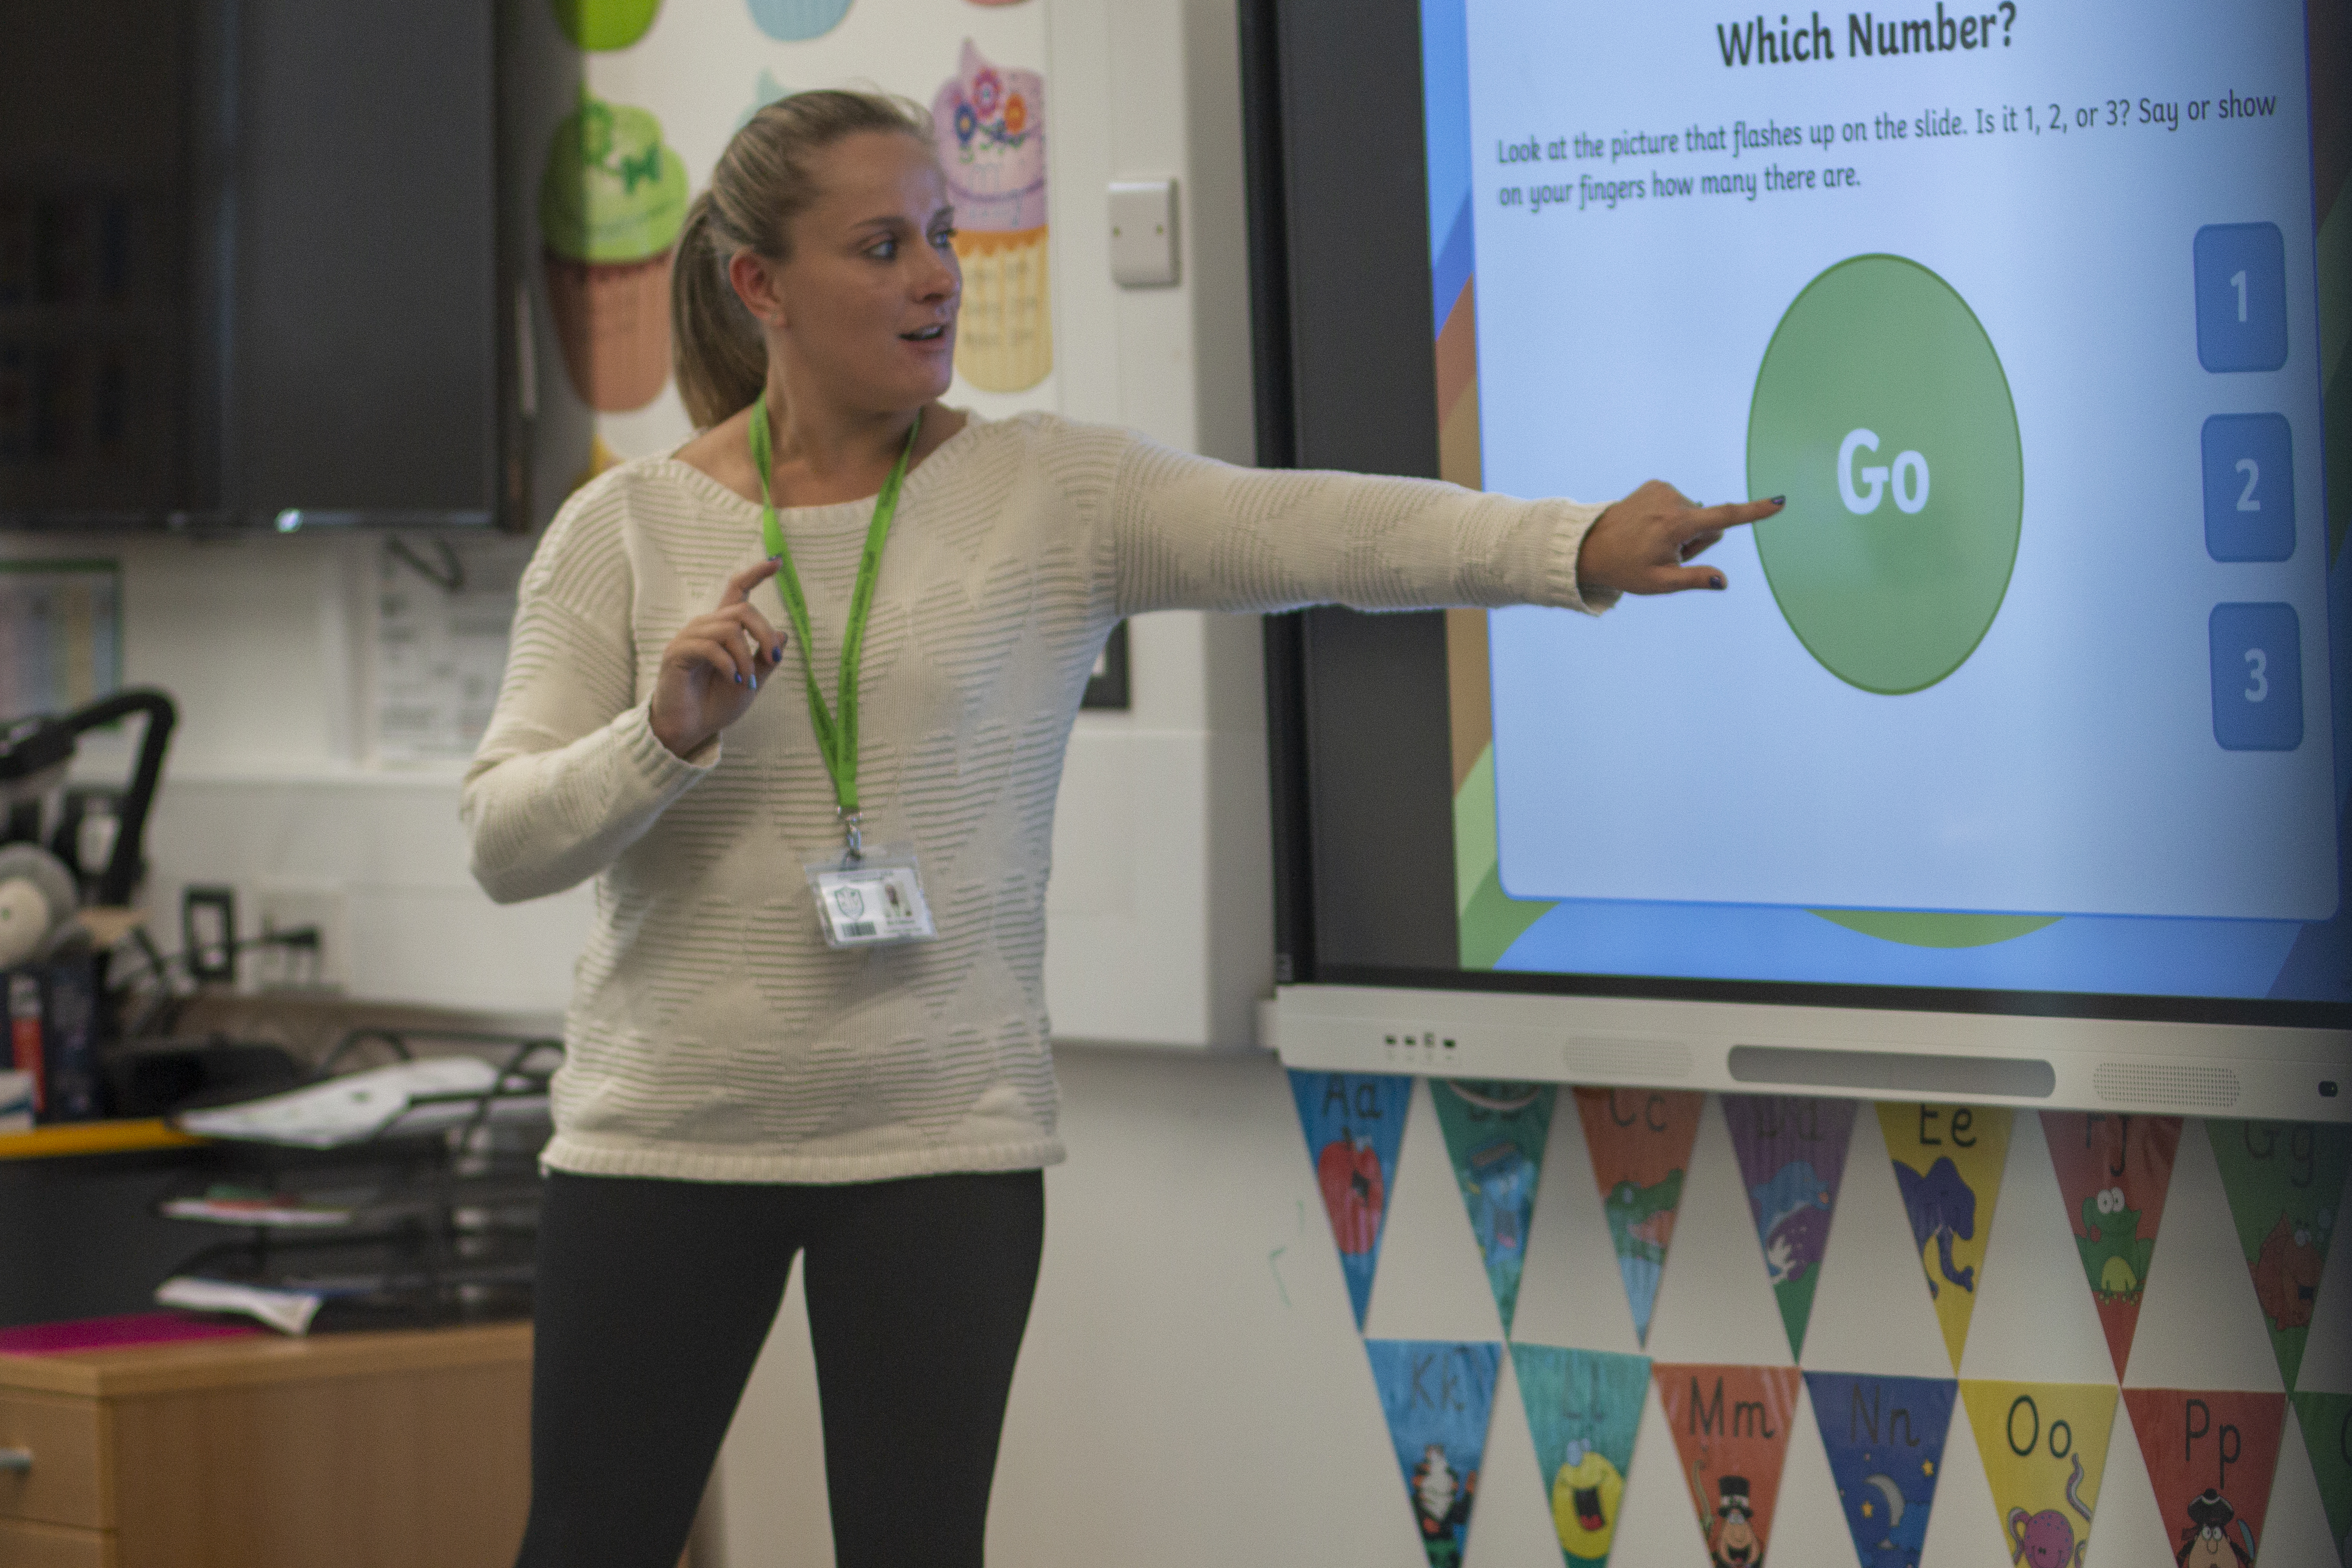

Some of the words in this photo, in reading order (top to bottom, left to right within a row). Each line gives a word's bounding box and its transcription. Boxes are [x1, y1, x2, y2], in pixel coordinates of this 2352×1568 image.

[1717, 11, 1835, 66] Which
[1848, 1, 2016, 57] Number?
[1498, 135, 1540, 163] Look
[1547, 137, 1566, 161] at
[1574, 131, 1603, 158] the
[1612, 130, 1678, 163] picture
[1687, 124, 1726, 152] that
[1733, 120, 1802, 158] flashes
[1810, 124, 1834, 151] up
[1842, 122, 1867, 142] on
[1874, 112, 1908, 140] the
[1914, 108, 1967, 137] slide.
[1976, 108, 1995, 134] Is
[2003, 106, 2018, 132] it
[2025, 106, 2040, 134] 1,
[2049, 104, 2067, 133] 2,
[2076, 103, 2098, 126] or
[2107, 99, 2130, 125] 3?
[2139, 98, 2178, 131] Say
[2188, 99, 2210, 121] or
[2218, 90, 2276, 118] show
[1500, 186, 1522, 205] on
[1530, 183, 1573, 212] your
[1580, 174, 1645, 210] fingers
[1653, 170, 1693, 196] how
[1701, 173, 1756, 201] many
[1765, 164, 1815, 191] there
[1824, 165, 1861, 187] are.
[2229, 270, 2248, 322] 1
[1838, 428, 1929, 514] Go
[2235, 458, 2260, 511] 2
[2244, 648, 2268, 703] 3
[1321, 1073, 1383, 1120] Aa
[1918, 1104, 1976, 1148] Ee
[1689, 1376, 1775, 1439] Mm
[1849, 1383, 1921, 1448] Nn
[2007, 1394, 2072, 1459] Oo
[2184, 1399, 2242, 1489] Pp
